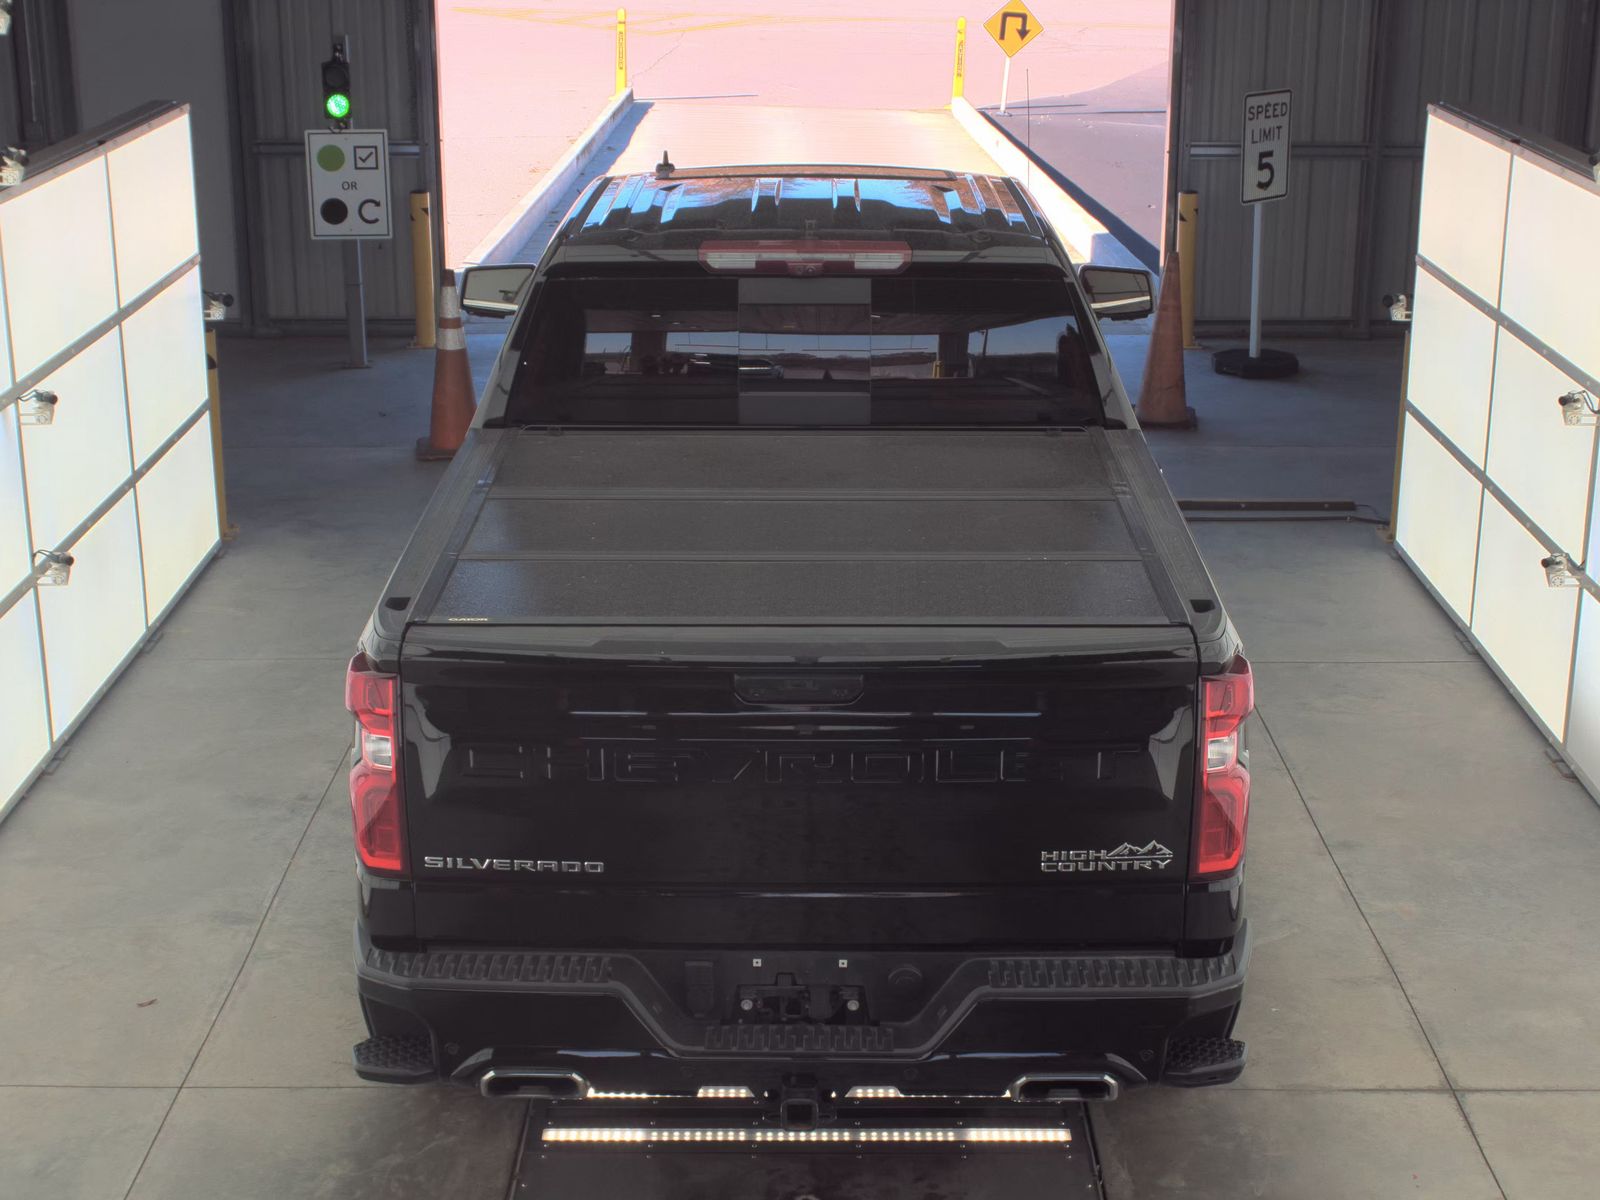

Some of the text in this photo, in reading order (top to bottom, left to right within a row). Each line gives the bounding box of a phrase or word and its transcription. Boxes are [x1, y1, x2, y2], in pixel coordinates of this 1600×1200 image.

[1247, 102, 1288, 121] SPEED
[1251, 125, 1282, 144] LIMIT
[1256, 150, 1275, 191] 5
[341, 181, 358, 191] OR
[460, 745, 1140, 784] CHEVROLET
[424, 856, 605, 873] SILVERADO
[1041, 849, 1108, 862] HIGH
[1040, 859, 1173, 873] COUNTRY
